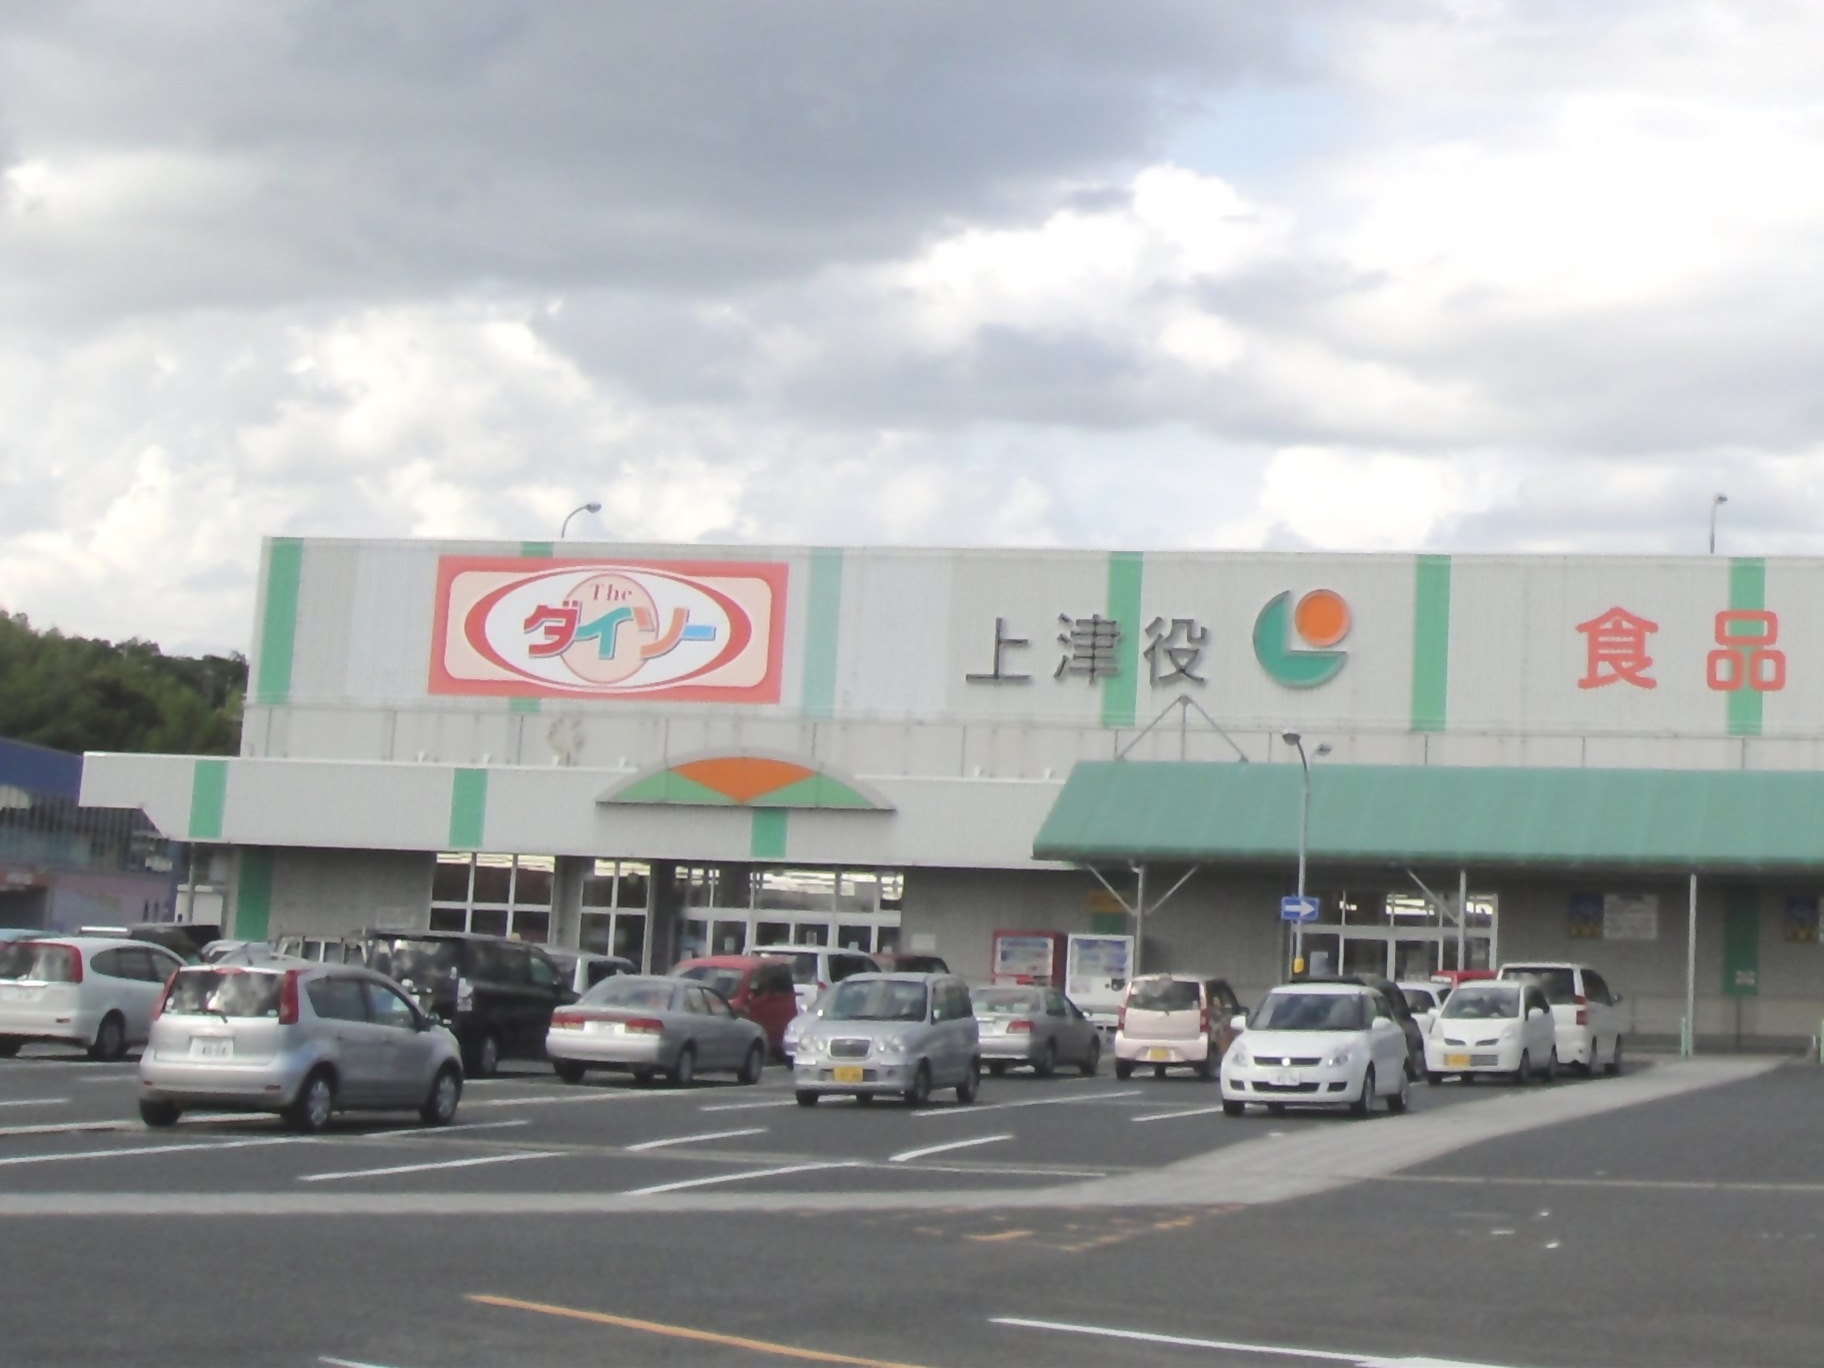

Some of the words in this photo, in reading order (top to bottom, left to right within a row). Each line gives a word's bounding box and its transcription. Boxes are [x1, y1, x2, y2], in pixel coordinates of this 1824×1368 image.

[591, 583, 633, 603] The
[523, 599, 716, 660] ダイソー
[965, 613, 1208, 688] 上津役
